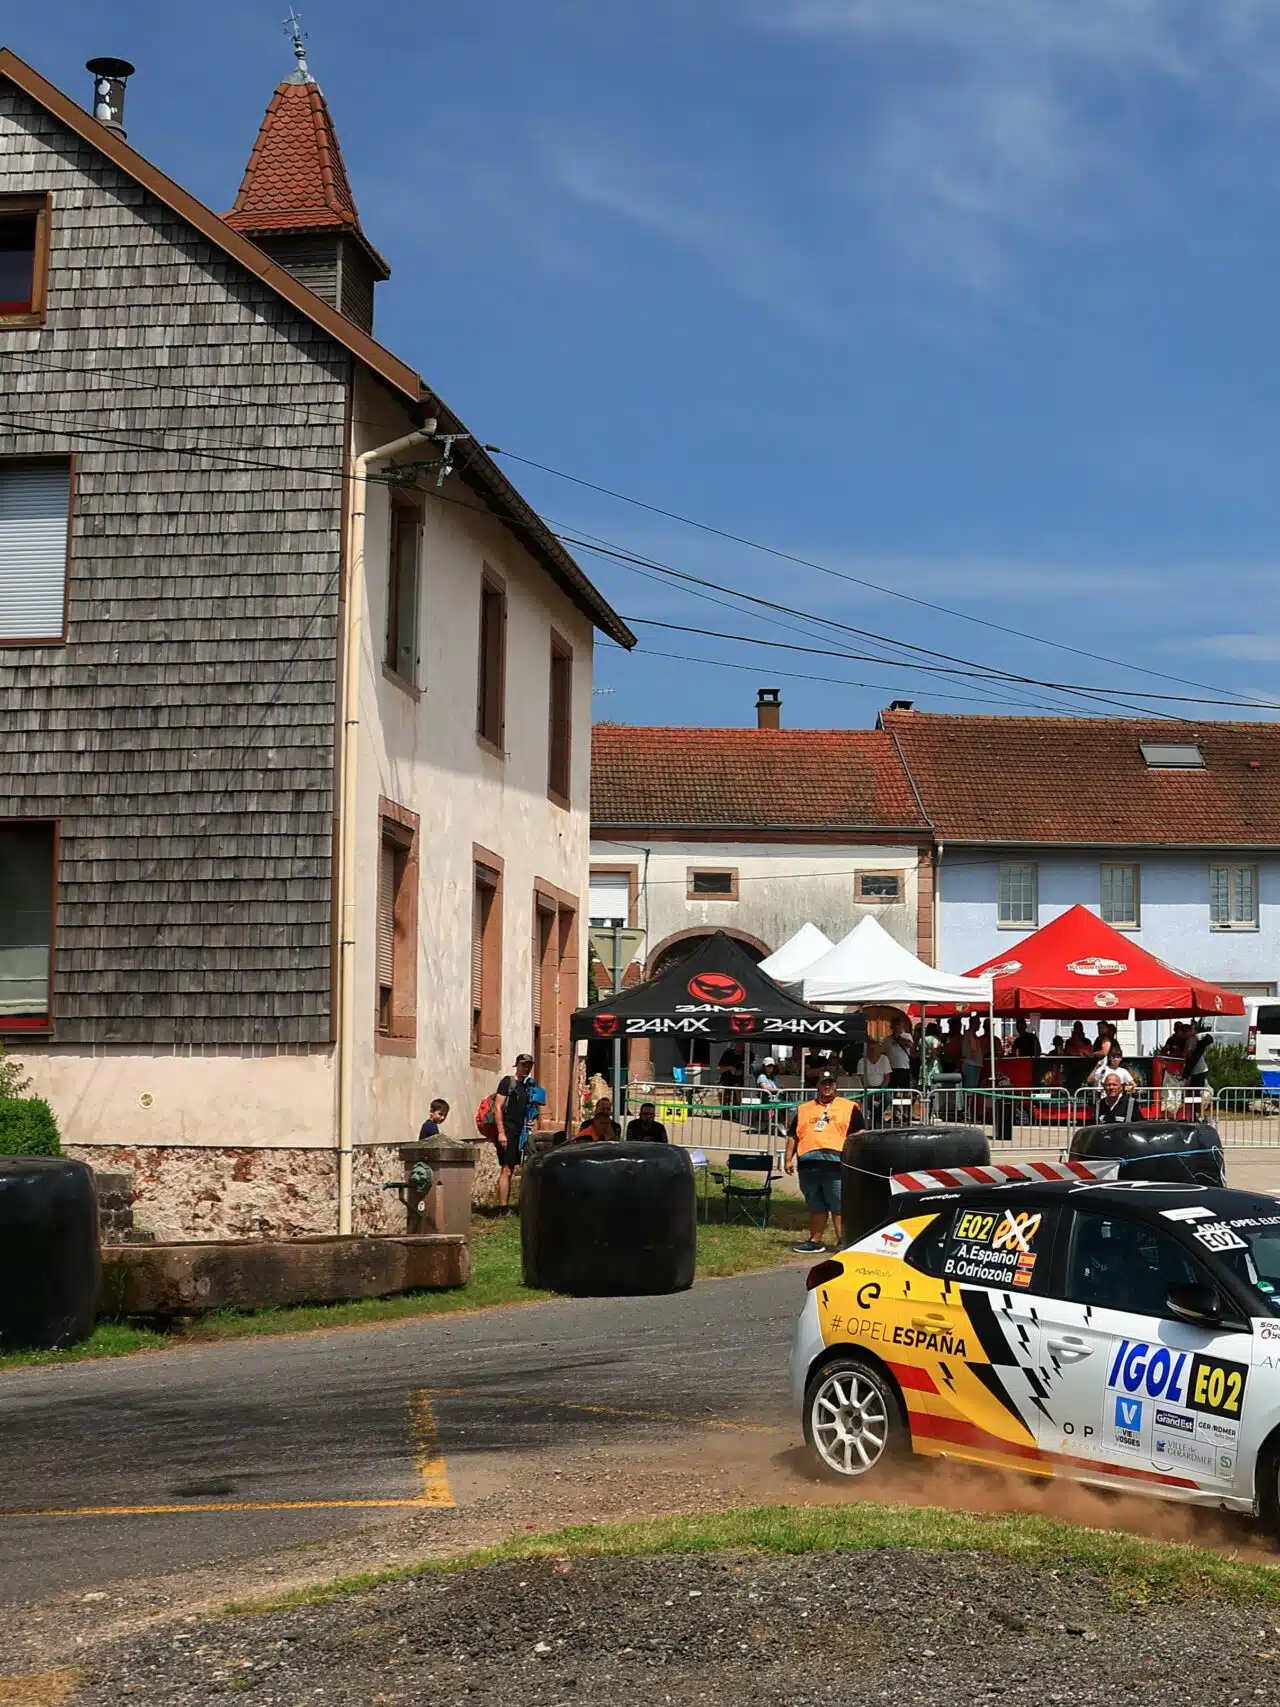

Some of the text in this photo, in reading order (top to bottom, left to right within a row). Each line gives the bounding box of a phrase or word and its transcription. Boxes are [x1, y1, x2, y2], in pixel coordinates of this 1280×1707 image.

[675, 1004, 762, 1013] 24MX
[626, 1017, 711, 1033] 24MX
[763, 1017, 846, 1035] 24MX
[957, 1214, 994, 1240] E02
[1197, 1221, 1232, 1233] ADAC
[1232, 1217, 1261, 1228] OPEL
[1201, 1231, 1241, 1248] E02
[957, 1244, 1019, 1266] A.Español
[944, 1260, 1013, 1283] B.Odriozola
[1108, 1340, 1188, 1402] IGOL
[1194, 1364, 1242, 1412] E02
[1115, 1434, 1141, 1447] VOSGES
[1122, 1429, 1133, 1437] VIE
[1168, 1440, 1187, 1451] VILLE
